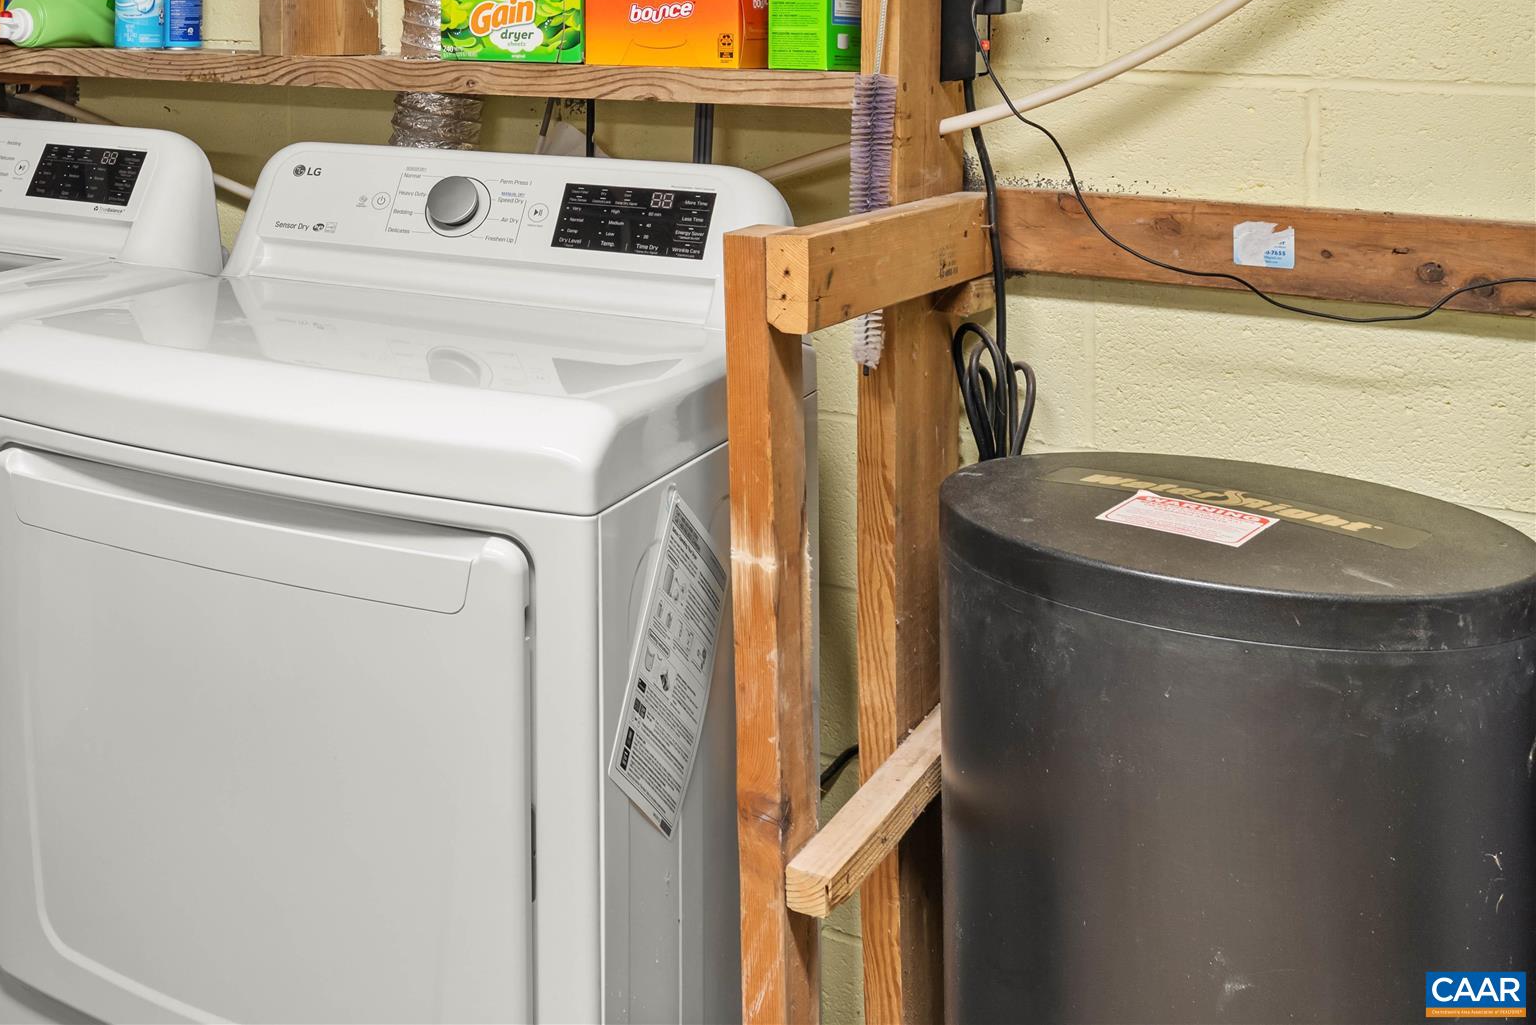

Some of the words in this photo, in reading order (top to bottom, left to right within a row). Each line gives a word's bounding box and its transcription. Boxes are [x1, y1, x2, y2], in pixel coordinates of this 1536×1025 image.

[629, 1, 694, 23] bounce
[500, 29, 534, 42] dryer
[650, 192, 674, 208] 88
[275, 221, 296, 230] Sensor
[297, 222, 310, 232] Dry
[1145, 496, 1259, 521] WARNING
